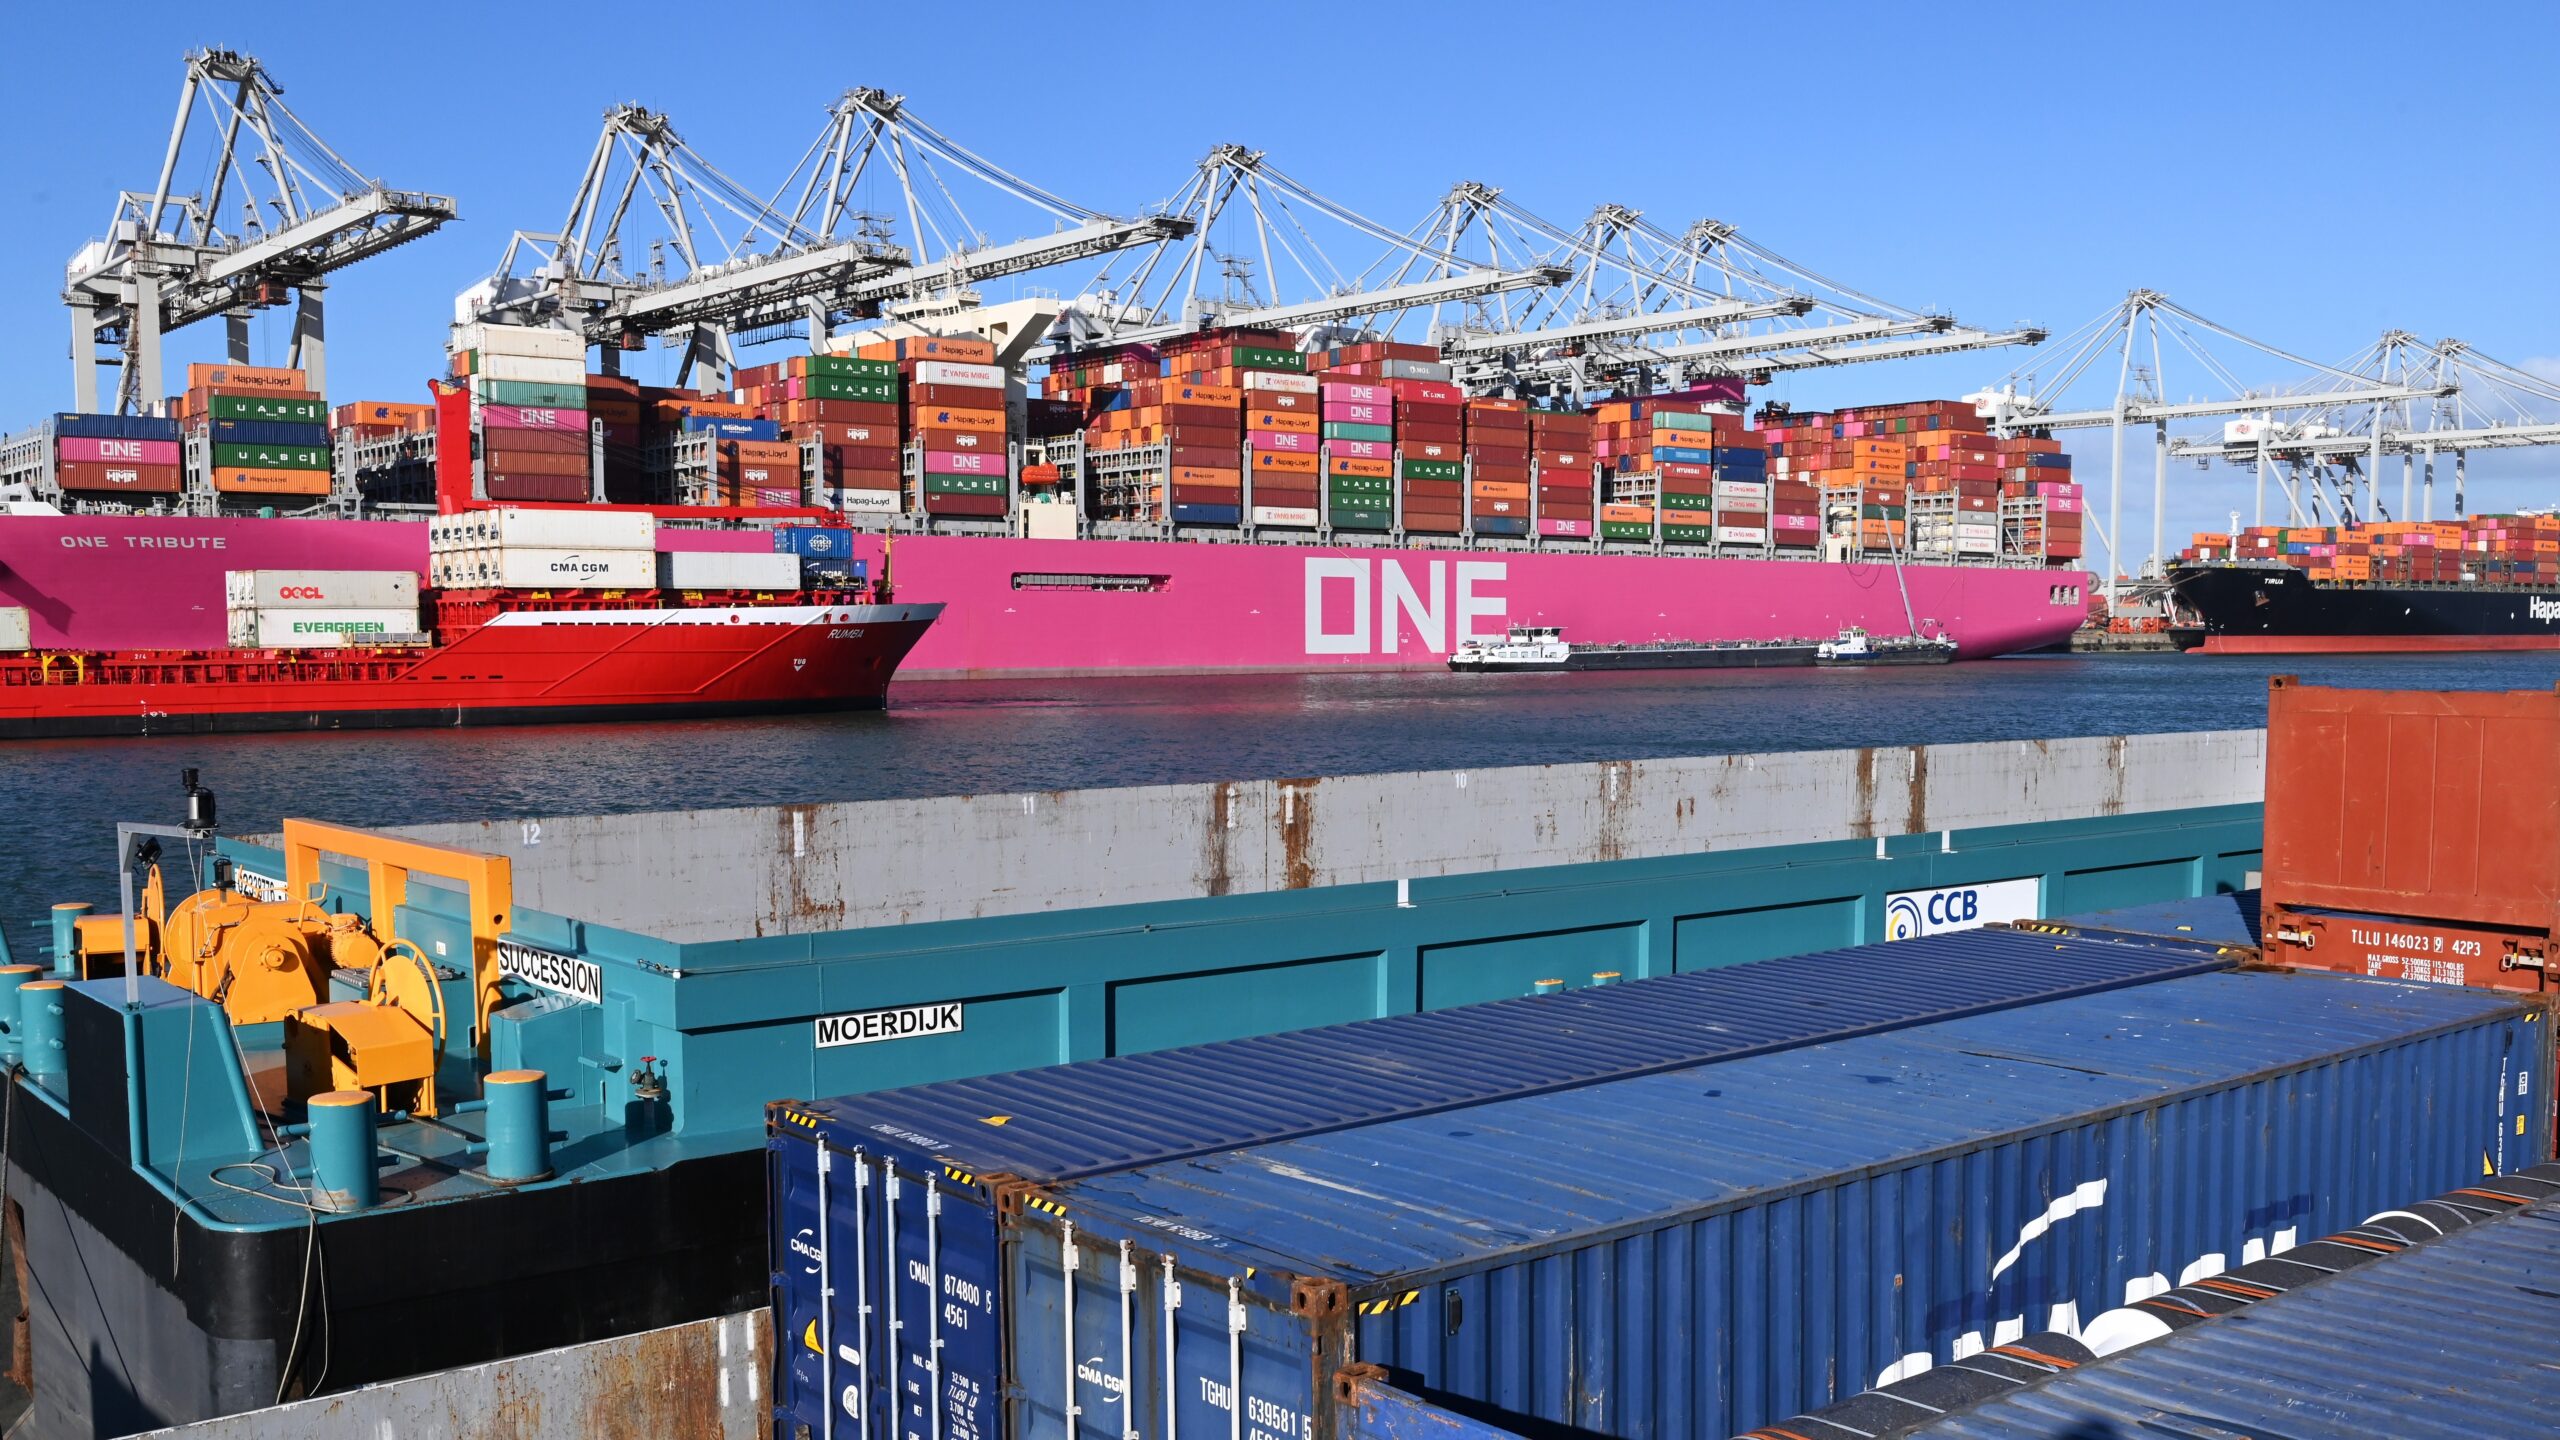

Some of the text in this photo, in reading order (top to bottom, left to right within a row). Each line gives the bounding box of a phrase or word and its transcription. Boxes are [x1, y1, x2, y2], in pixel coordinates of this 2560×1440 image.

[942, 346, 983, 357] Hapag-Lloyd
[233, 373, 291, 387] Hapag-Lloyd
[950, 370, 990, 380] YANG MING
[1195, 391, 1231, 401] Hapag-Lloyd
[1350, 387, 1373, 399] ONE
[521, 409, 555, 424] ONE
[697, 410, 742, 418] Hapag-Lloyd
[1350, 406, 1373, 418] ONE
[954, 416, 995, 426] Hapag-Lloyd
[1275, 418, 1310, 427] Hapag-Lloyd
[847, 429, 869, 440] HMM
[1275, 434, 1298, 446] ONE
[956, 436, 977, 446] HMM
[100, 441, 142, 457] ONE
[742, 448, 788, 459] Hapag-Lloyd
[1350, 442, 1373, 454] ONE
[953, 455, 980, 468] ONE
[1275, 458, 1310, 467] Hapag-Lloyd
[1352, 464, 1384, 473] Hapag-Lloyd
[106, 470, 137, 483] HMM
[250, 475, 287, 485] Hapag-Lloyd
[745, 469, 768, 481] HMM
[2058, 485, 2072, 494] ONE
[847, 496, 890, 506] Hapag-Lloyd
[2058, 500, 2072, 509] ONE
[1289, 512, 1306, 520] MING
[1789, 517, 1805, 526] ONE
[1557, 521, 1575, 532] ONE
[60, 536, 226, 549] ONE TRIBUTE
[551, 563, 609, 573] CMA CGM
[280, 586, 324, 599] OOCL
[1305, 557, 1507, 654] ONE
[293, 622, 385, 633] EVERGREEN
[827, 629, 864, 639] RUMBA
[1455, 773, 1467, 789] 10
[1022, 797, 1034, 816] 11
[521, 823, 541, 845] 12
[1928, 889, 1978, 925] CCB
[2352, 929, 2481, 957] TLLU 146023 9 42P3
[499, 944, 599, 999] SUCCESSION
[2368, 961, 2381, 970] TARE
[818, 1006, 957, 1044] MOERDIJK
[791, 1238, 821, 1261] CMA CG
[944, 1274, 980, 1307] 874800
[986, 1290, 992, 1313] 5
[944, 1303, 968, 1330] 45G1
[1078, 1364, 1102, 1387] CMA
[908, 1380, 920, 1395] TARE
[952, 1371, 979, 1394] 32.500 KG
[949, 1400, 964, 1416] 3.700
[1200, 1376, 1231, 1410] TGHU
[1248, 1396, 1296, 1436] 639581
